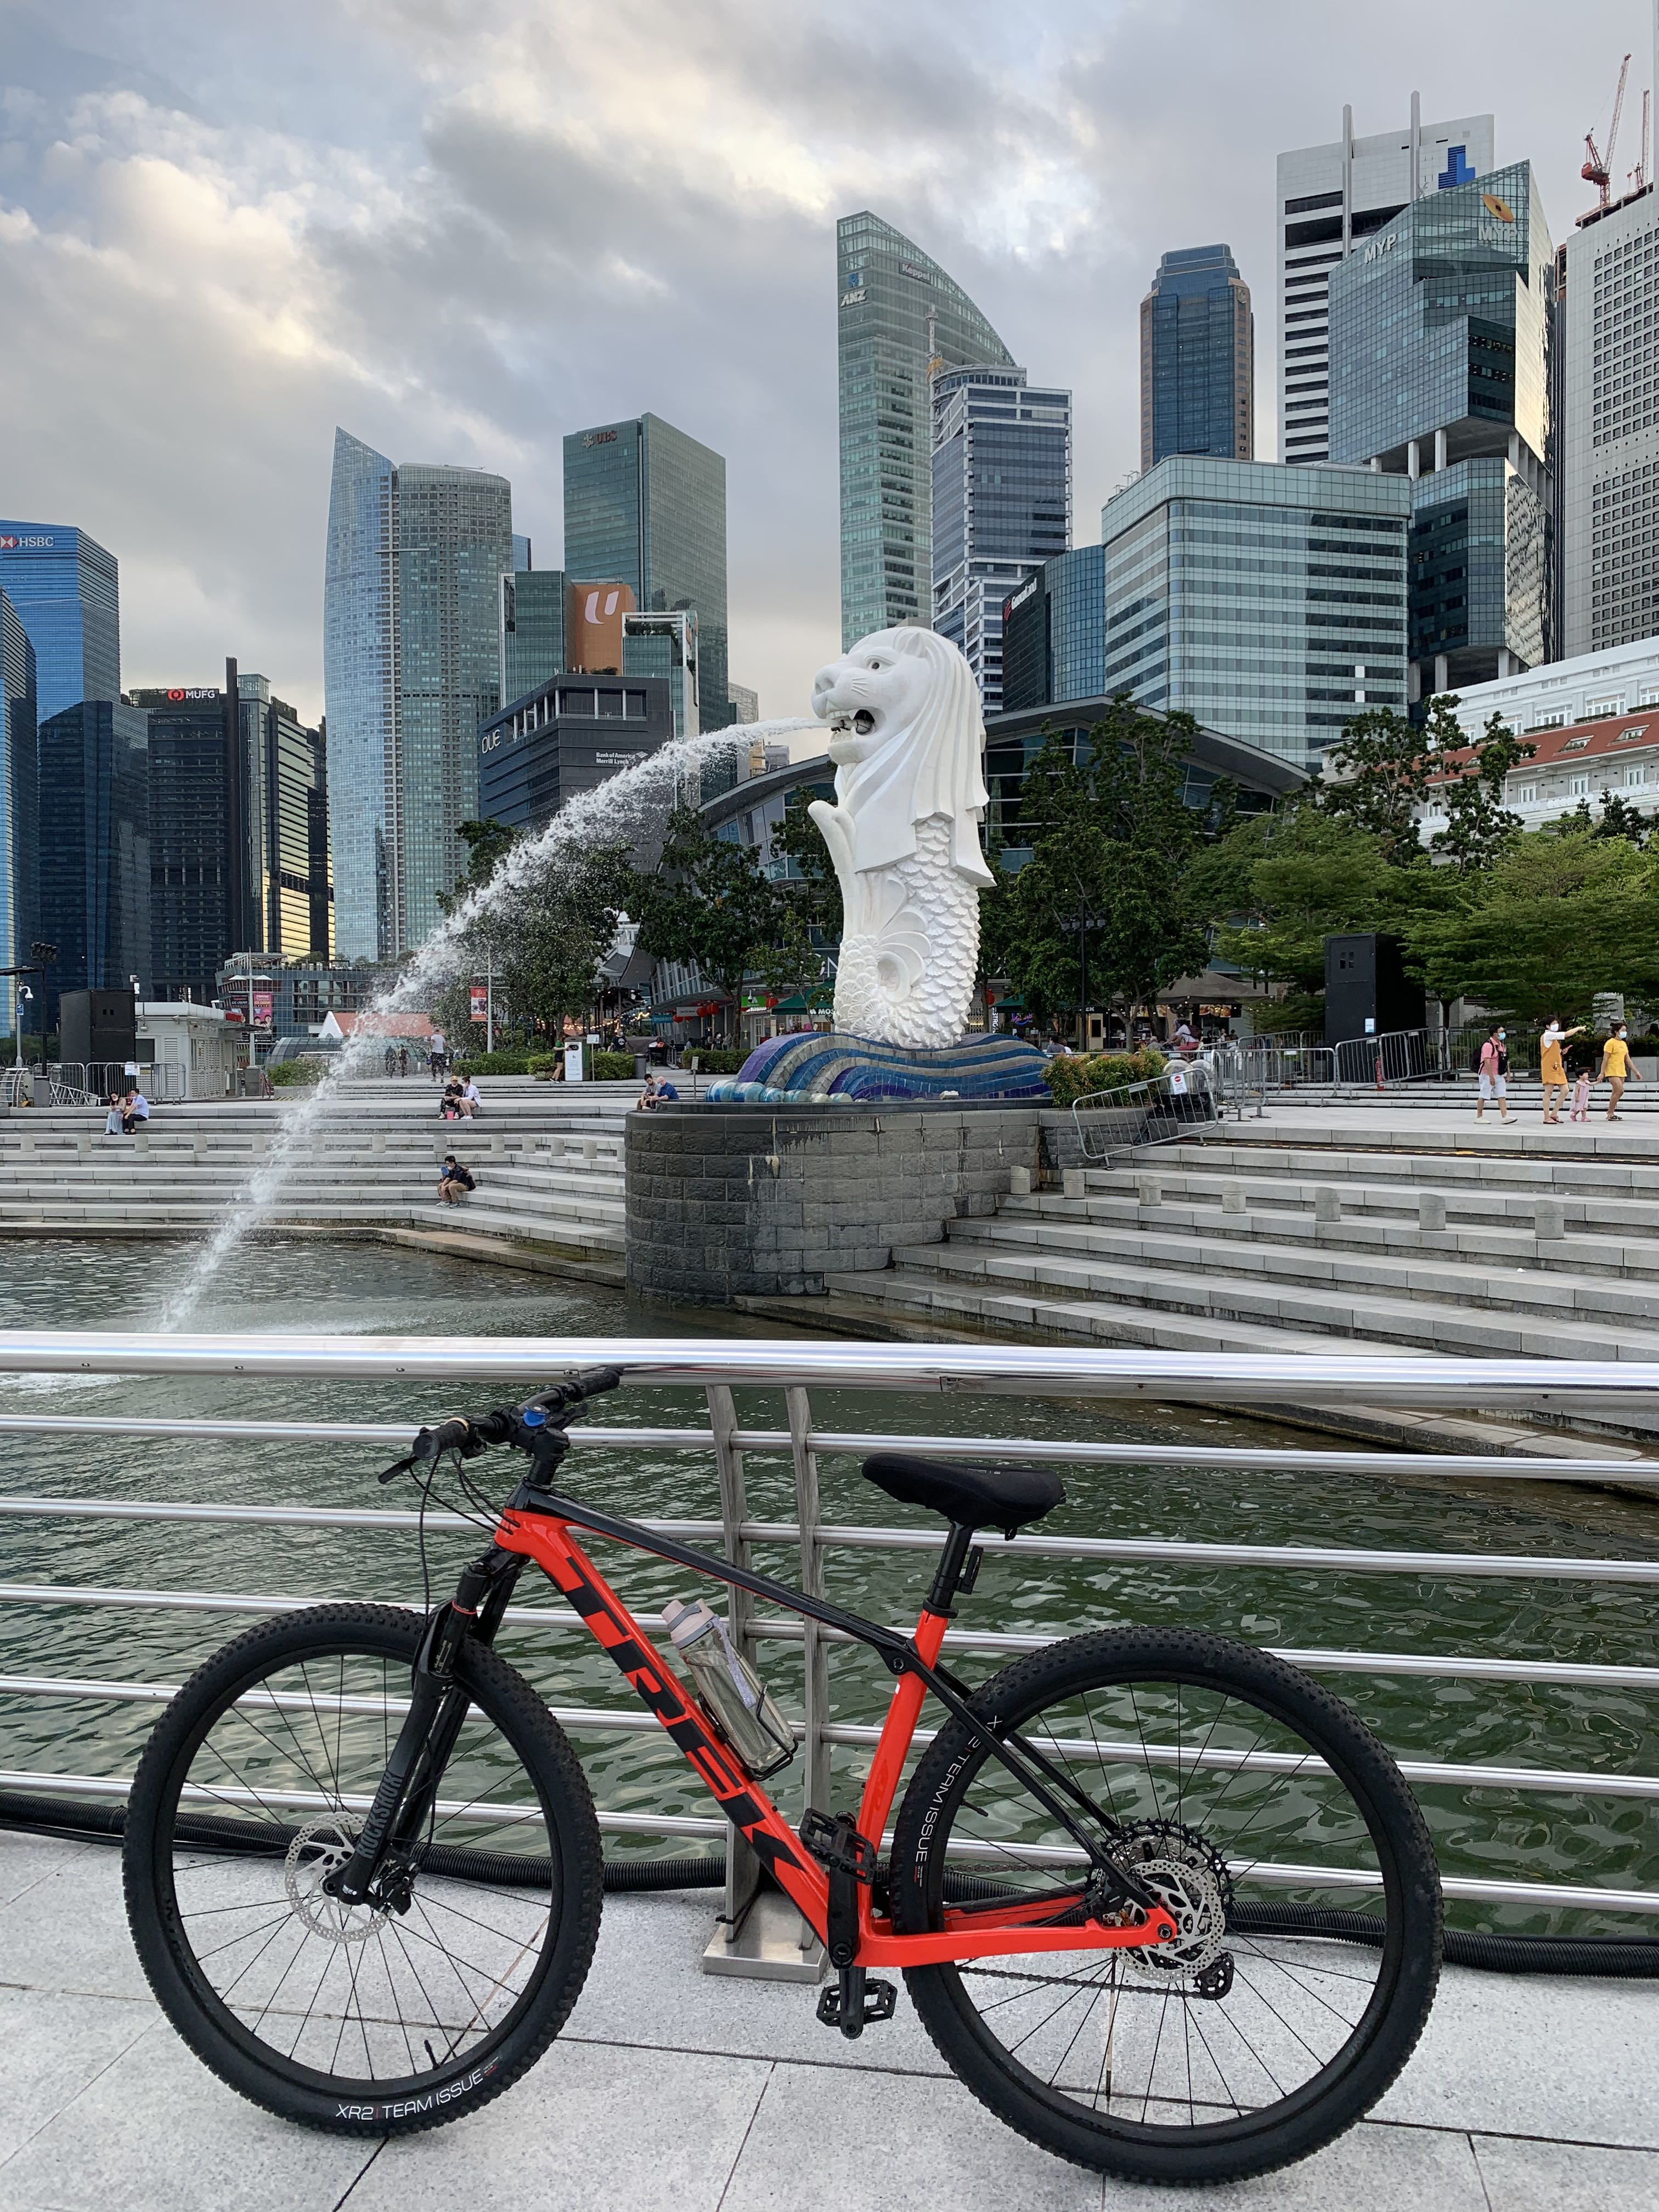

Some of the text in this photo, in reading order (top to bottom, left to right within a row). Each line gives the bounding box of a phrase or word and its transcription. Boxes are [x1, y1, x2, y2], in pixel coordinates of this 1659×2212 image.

[1478, 222, 1518, 242] MYP
[1364, 233, 1397, 264] MYP
[902, 263, 930, 281] Keppel
[840, 290, 867, 307] ANZ
[595, 430, 617, 444] UBS
[19, 537, 54, 547] HSBC
[185, 690, 215, 699] MUFG
[482, 729, 501, 754] OUE
[915, 1715, 1003, 1863] X2 TEAM ISSUE
[357, 1771, 404, 1860] ROCKSHOX
[335, 2068, 484, 2120] XR2 TEAM ISSUE
